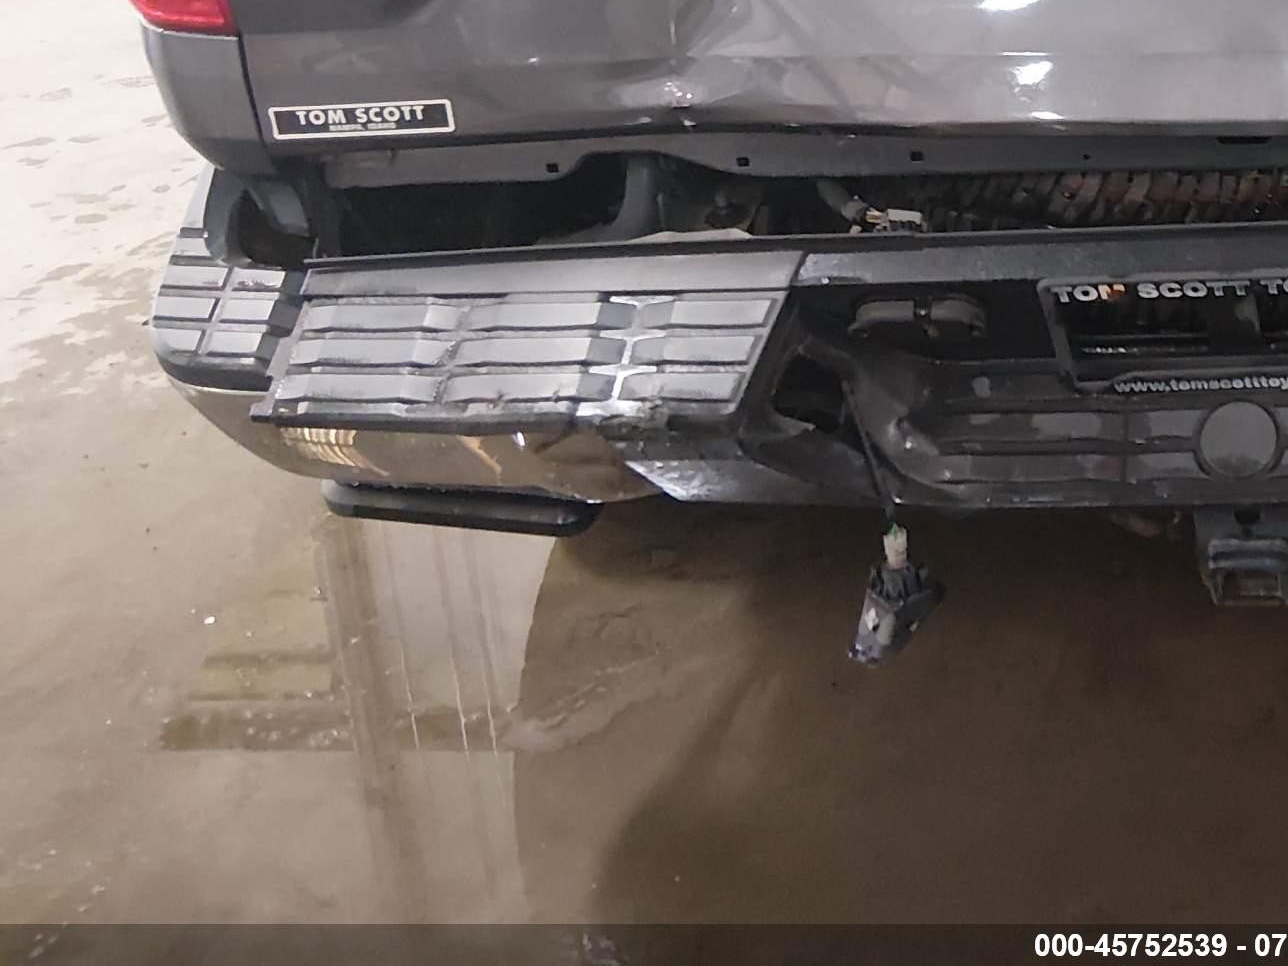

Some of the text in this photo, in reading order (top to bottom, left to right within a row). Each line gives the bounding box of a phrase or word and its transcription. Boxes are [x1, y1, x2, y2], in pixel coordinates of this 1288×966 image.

[295, 105, 424, 125] TOM SCOTT
[1136, 281, 1250, 299] SCOTT
